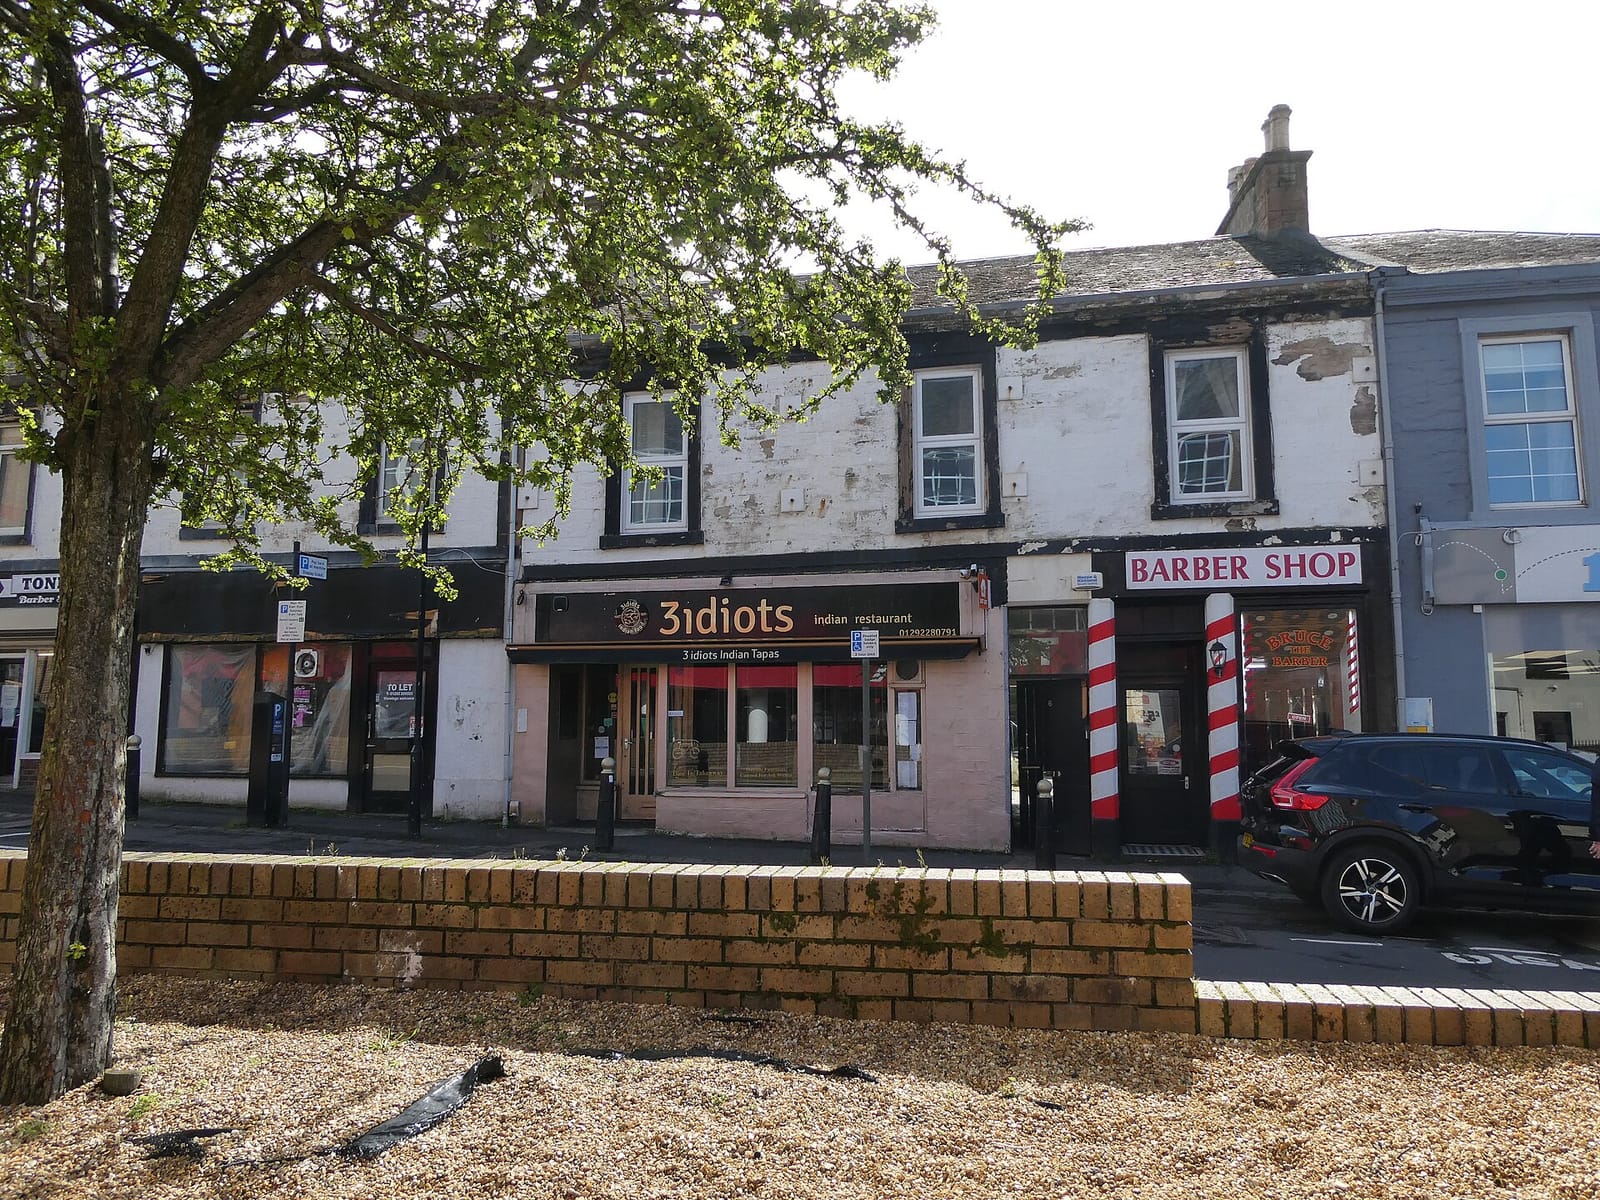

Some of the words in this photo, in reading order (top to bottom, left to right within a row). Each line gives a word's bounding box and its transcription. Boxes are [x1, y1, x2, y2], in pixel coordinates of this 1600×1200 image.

[1131, 555, 1250, 583] BARBER
[1264, 552, 1356, 579] SHOP
[22, 576, 60, 590] TON
[19, 595, 55, 604] Barber
[659, 596, 794, 635] 3idiots
[814, 614, 848, 625] indian
[855, 613, 912, 624] restaurant
[854, 632, 861, 641] P
[899, 628, 957, 637] 01292280791
[1265, 630, 1334, 651] BRUCE
[682, 651, 689, 660] 3
[690, 650, 718, 660] idiots
[720, 650, 750, 659] Indian
[751, 649, 780, 661] Tapas
[1289, 646, 1312, 654] THE
[1272, 656, 1329, 667] BARBER
[387, 683, 397, 691] TO
[398, 683, 413, 691] LET
[274, 703, 281, 716] P
